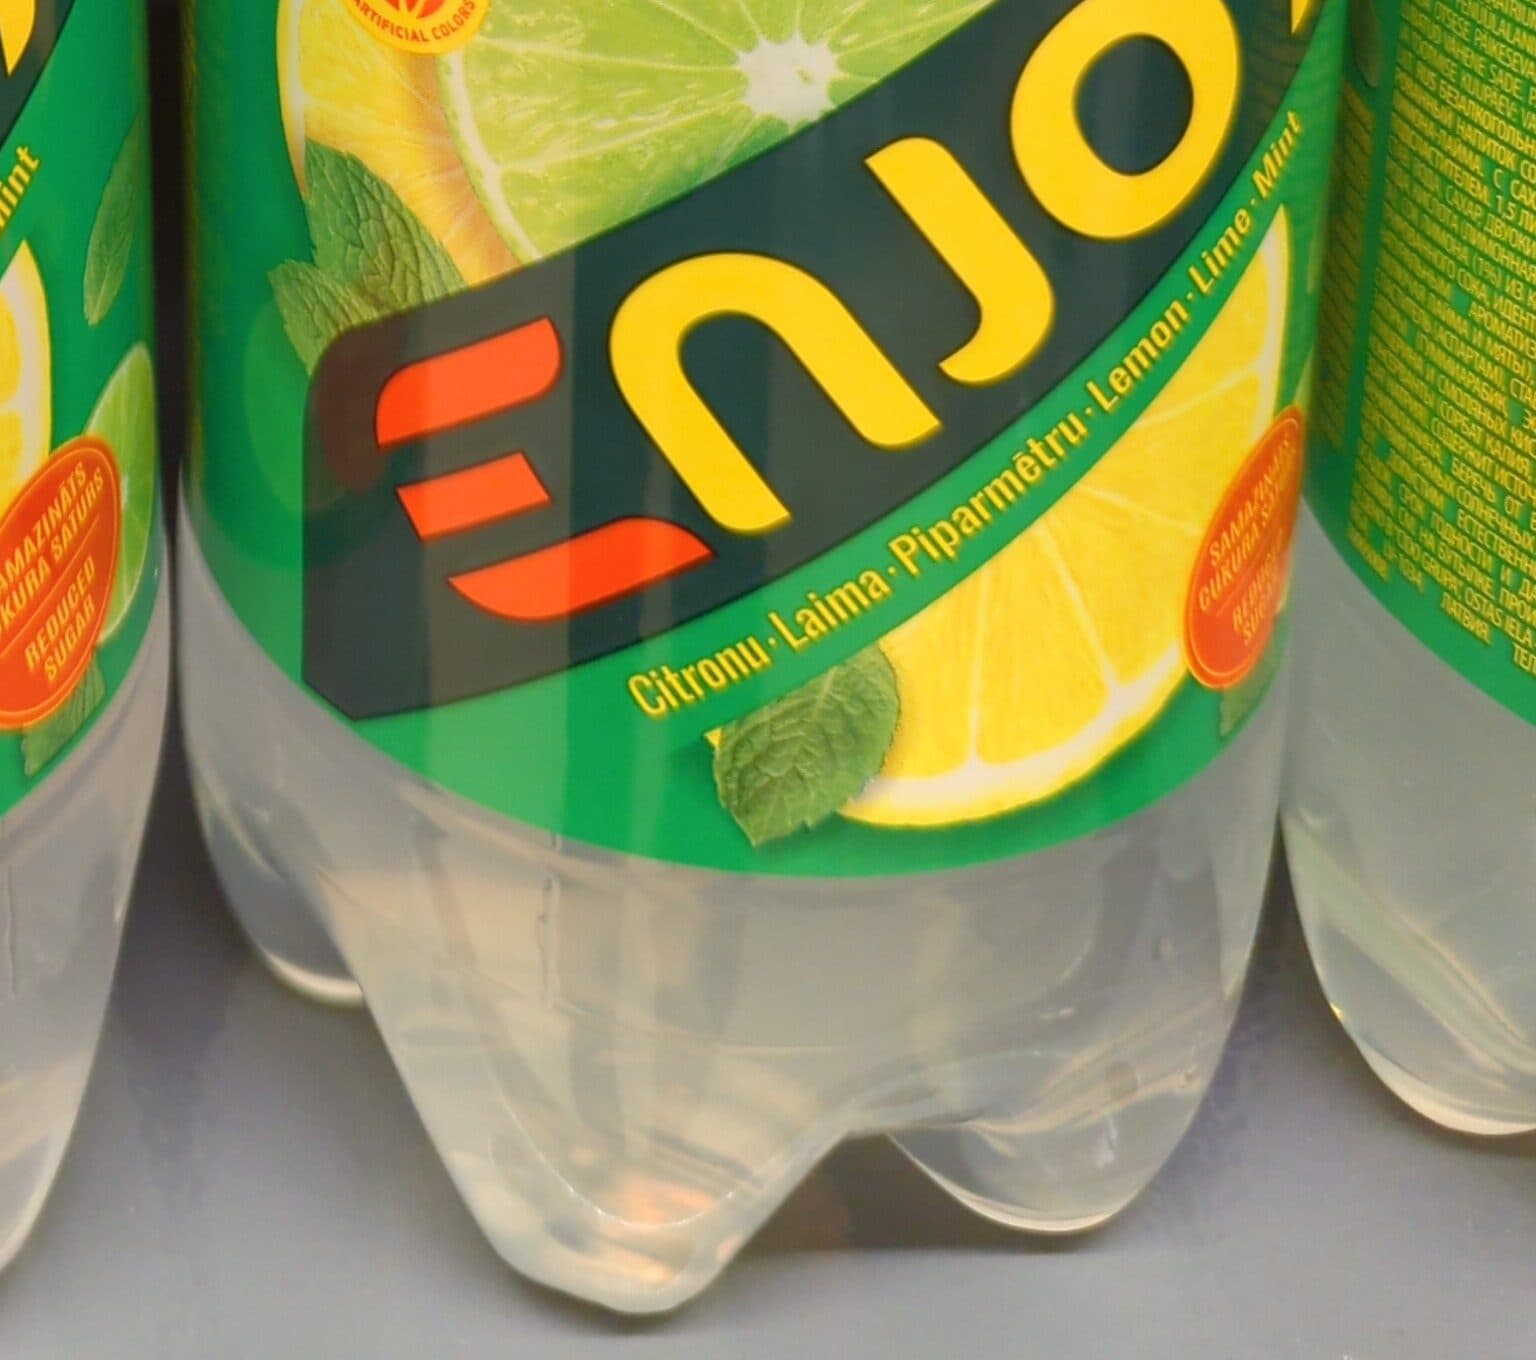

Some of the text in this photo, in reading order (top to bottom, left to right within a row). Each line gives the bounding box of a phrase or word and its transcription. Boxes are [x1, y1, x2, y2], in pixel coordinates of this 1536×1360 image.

[627, 110, 1306, 720] Citronu Laima Piparmētru Lemon Lime Mint
[50, 465, 105, 561] SATURS
[23, 554, 97, 672] REDUCED
[42, 593, 97, 683] SUGAR
